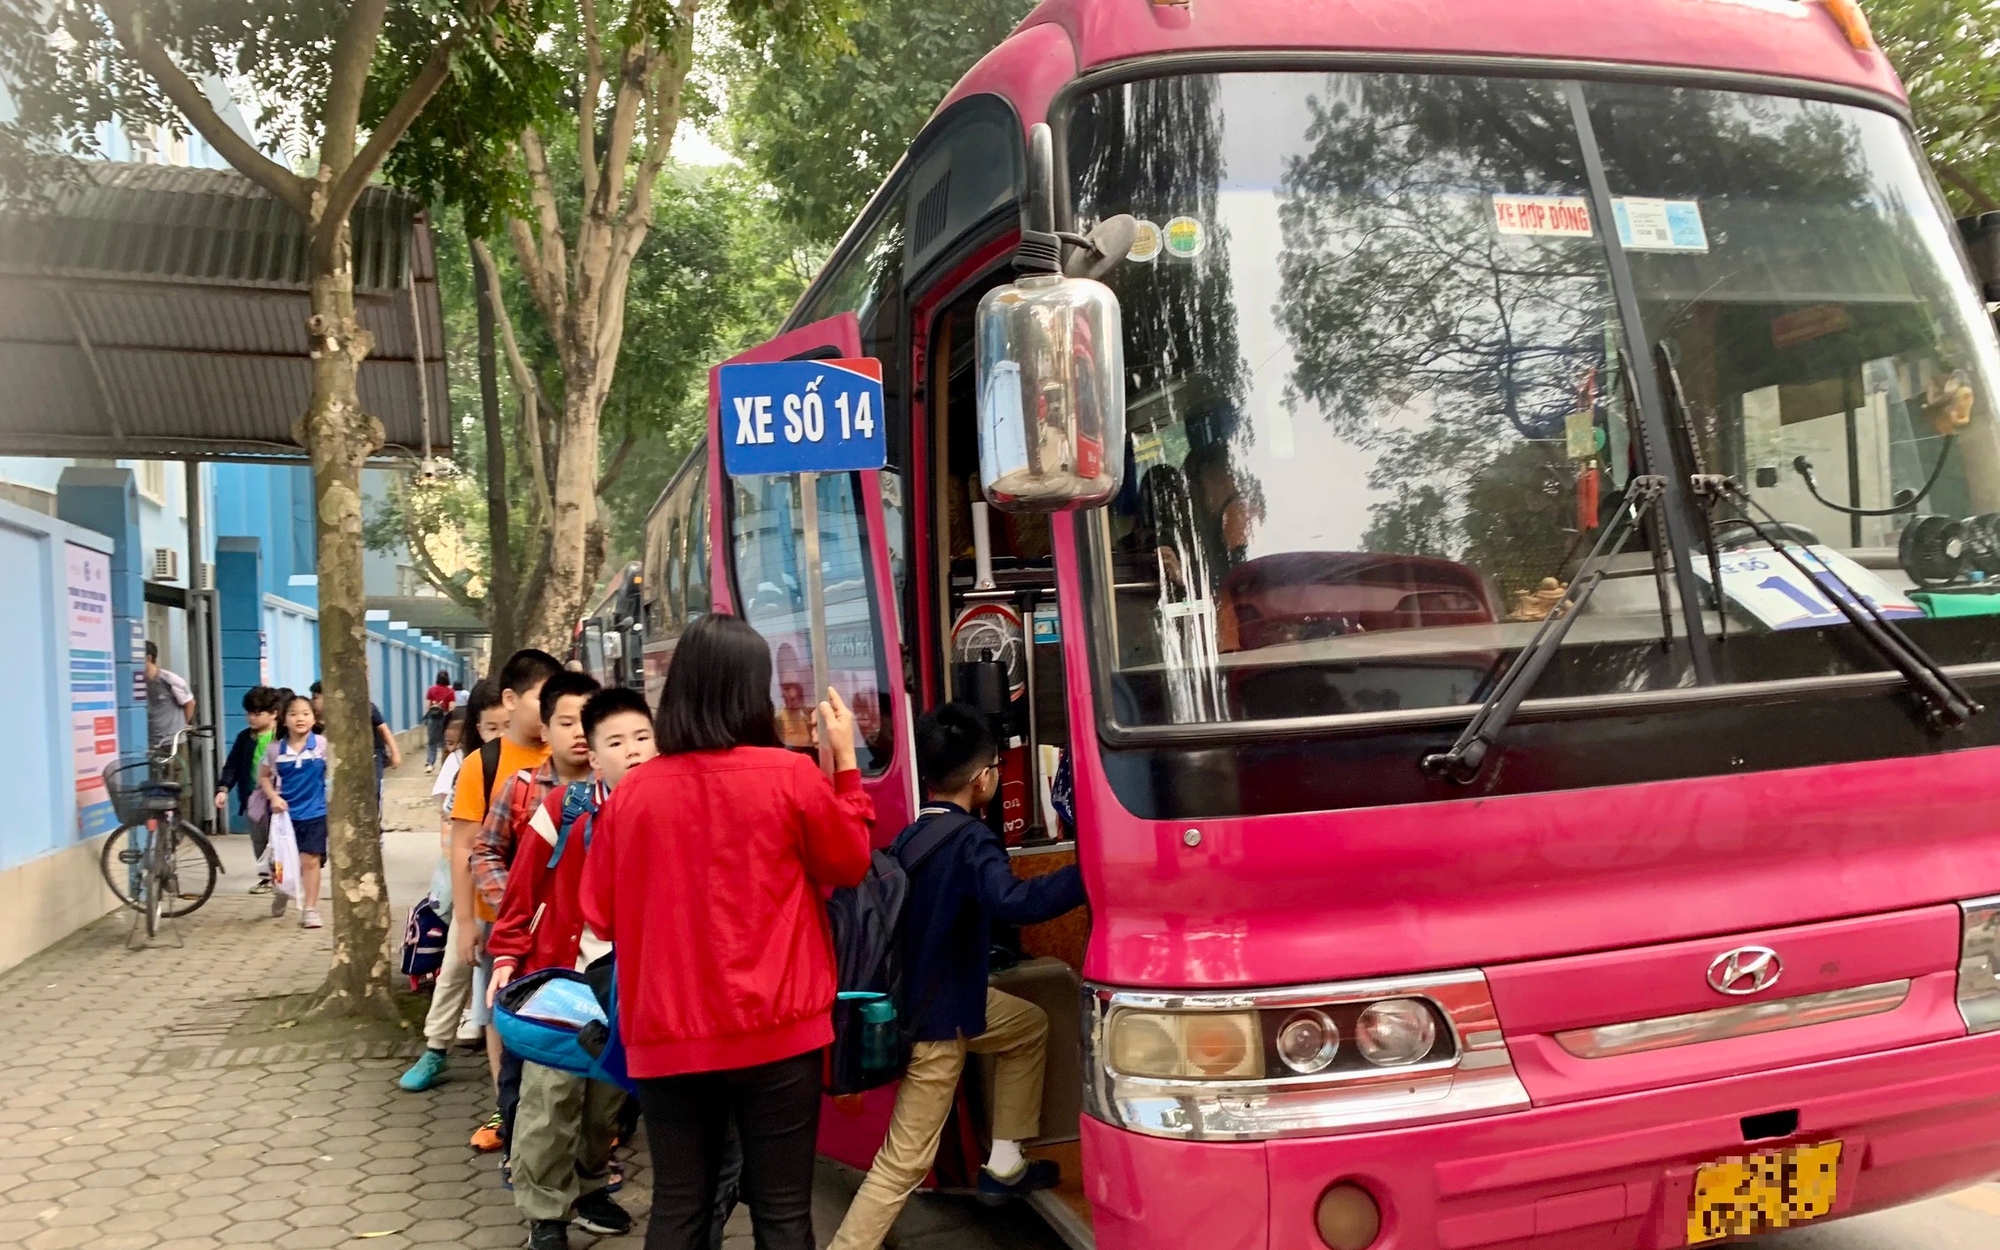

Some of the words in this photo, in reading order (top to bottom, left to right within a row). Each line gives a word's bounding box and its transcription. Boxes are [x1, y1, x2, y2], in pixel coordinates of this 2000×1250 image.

[733, 395, 774, 445] XE
[783, 375, 825, 443] SỐ
[834, 391, 874, 440] 14
